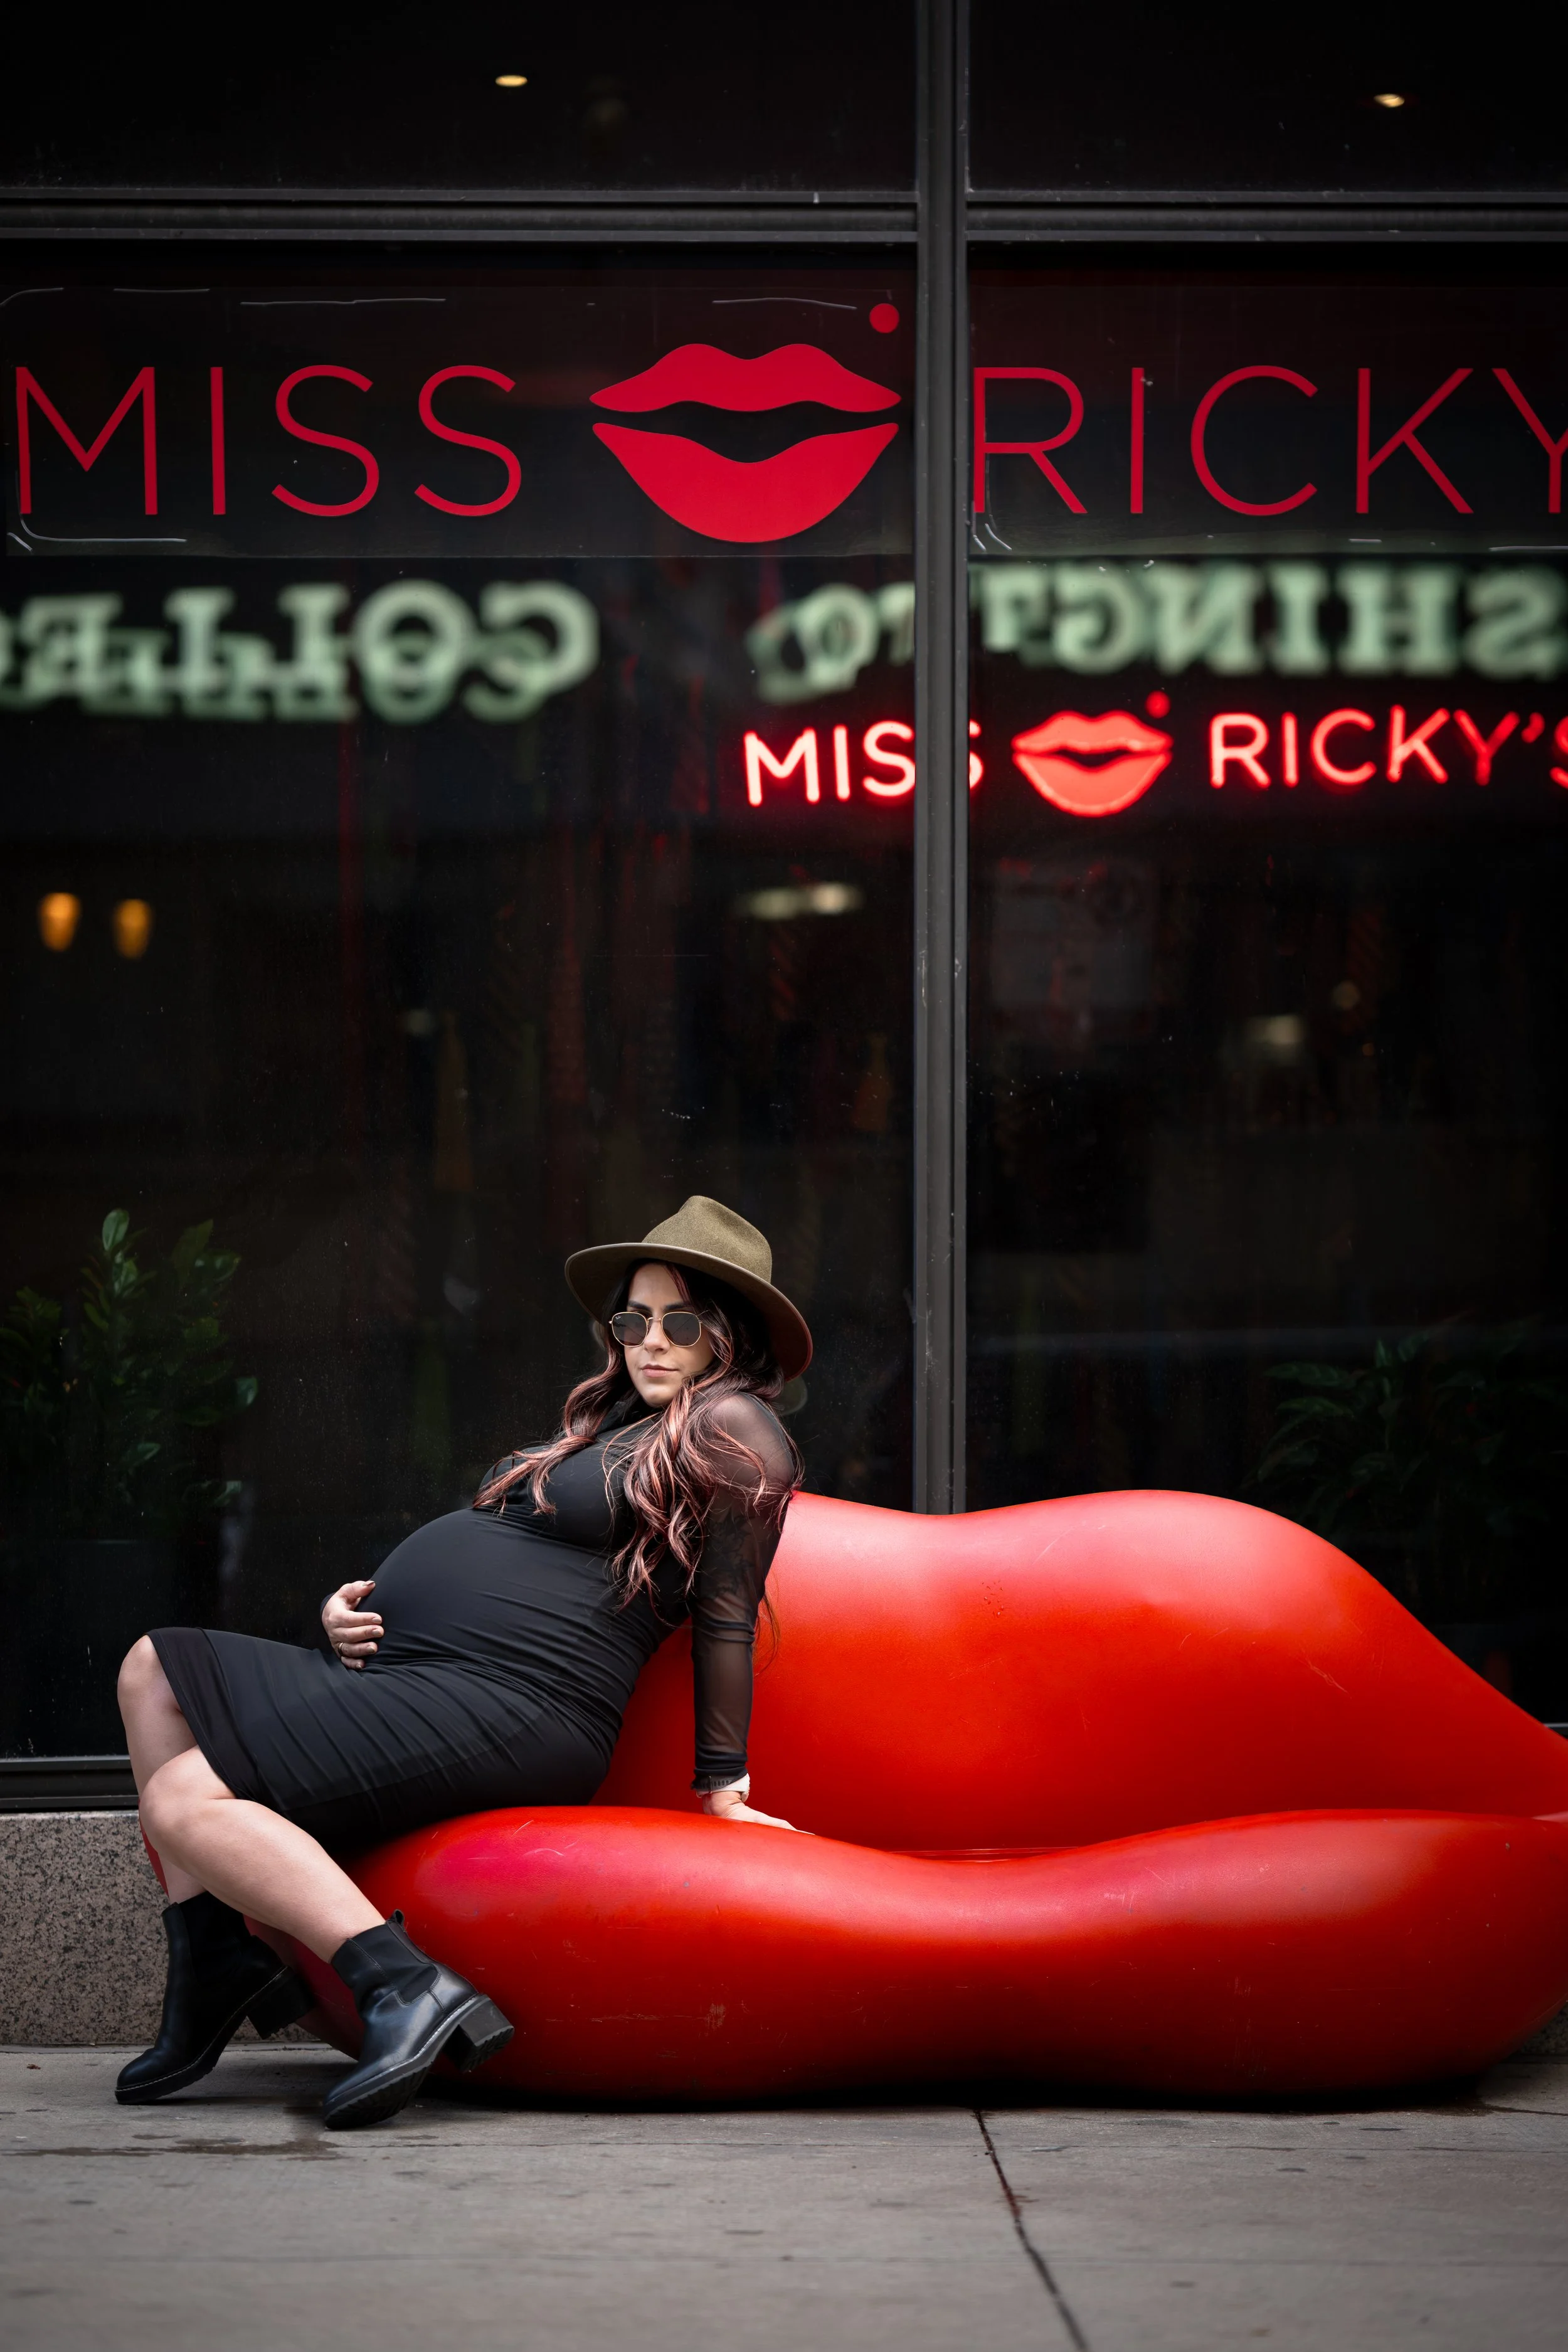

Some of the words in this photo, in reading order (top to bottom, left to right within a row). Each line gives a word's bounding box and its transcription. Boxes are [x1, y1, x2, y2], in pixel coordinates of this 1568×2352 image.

[15, 364, 522, 517] MISS
[973, 365, 1568, 516] RICKY
[744, 719, 985, 807] MIS
